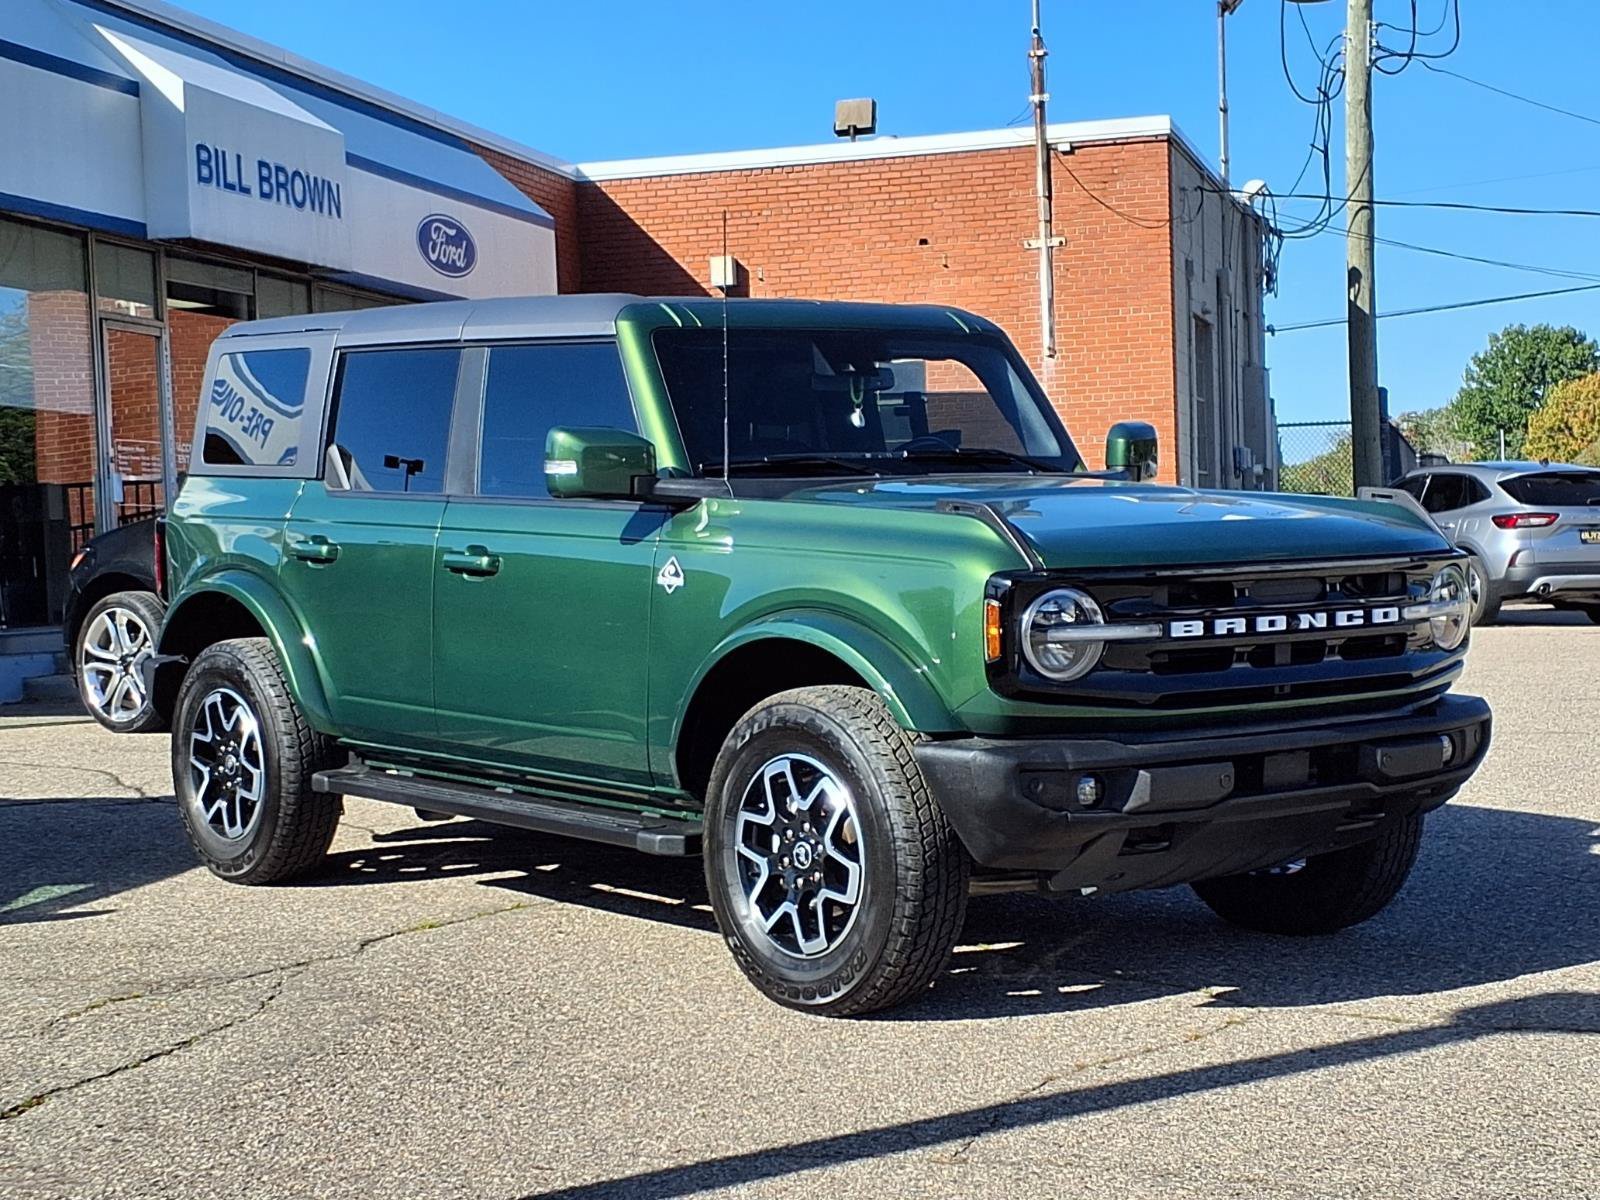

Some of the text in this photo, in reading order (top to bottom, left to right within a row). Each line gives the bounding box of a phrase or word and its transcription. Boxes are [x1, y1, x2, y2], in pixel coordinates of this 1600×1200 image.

[195, 143, 342, 219] BILL BROWN
[428, 222, 467, 268] Ford
[1170, 607, 1399, 637] BRONCO
